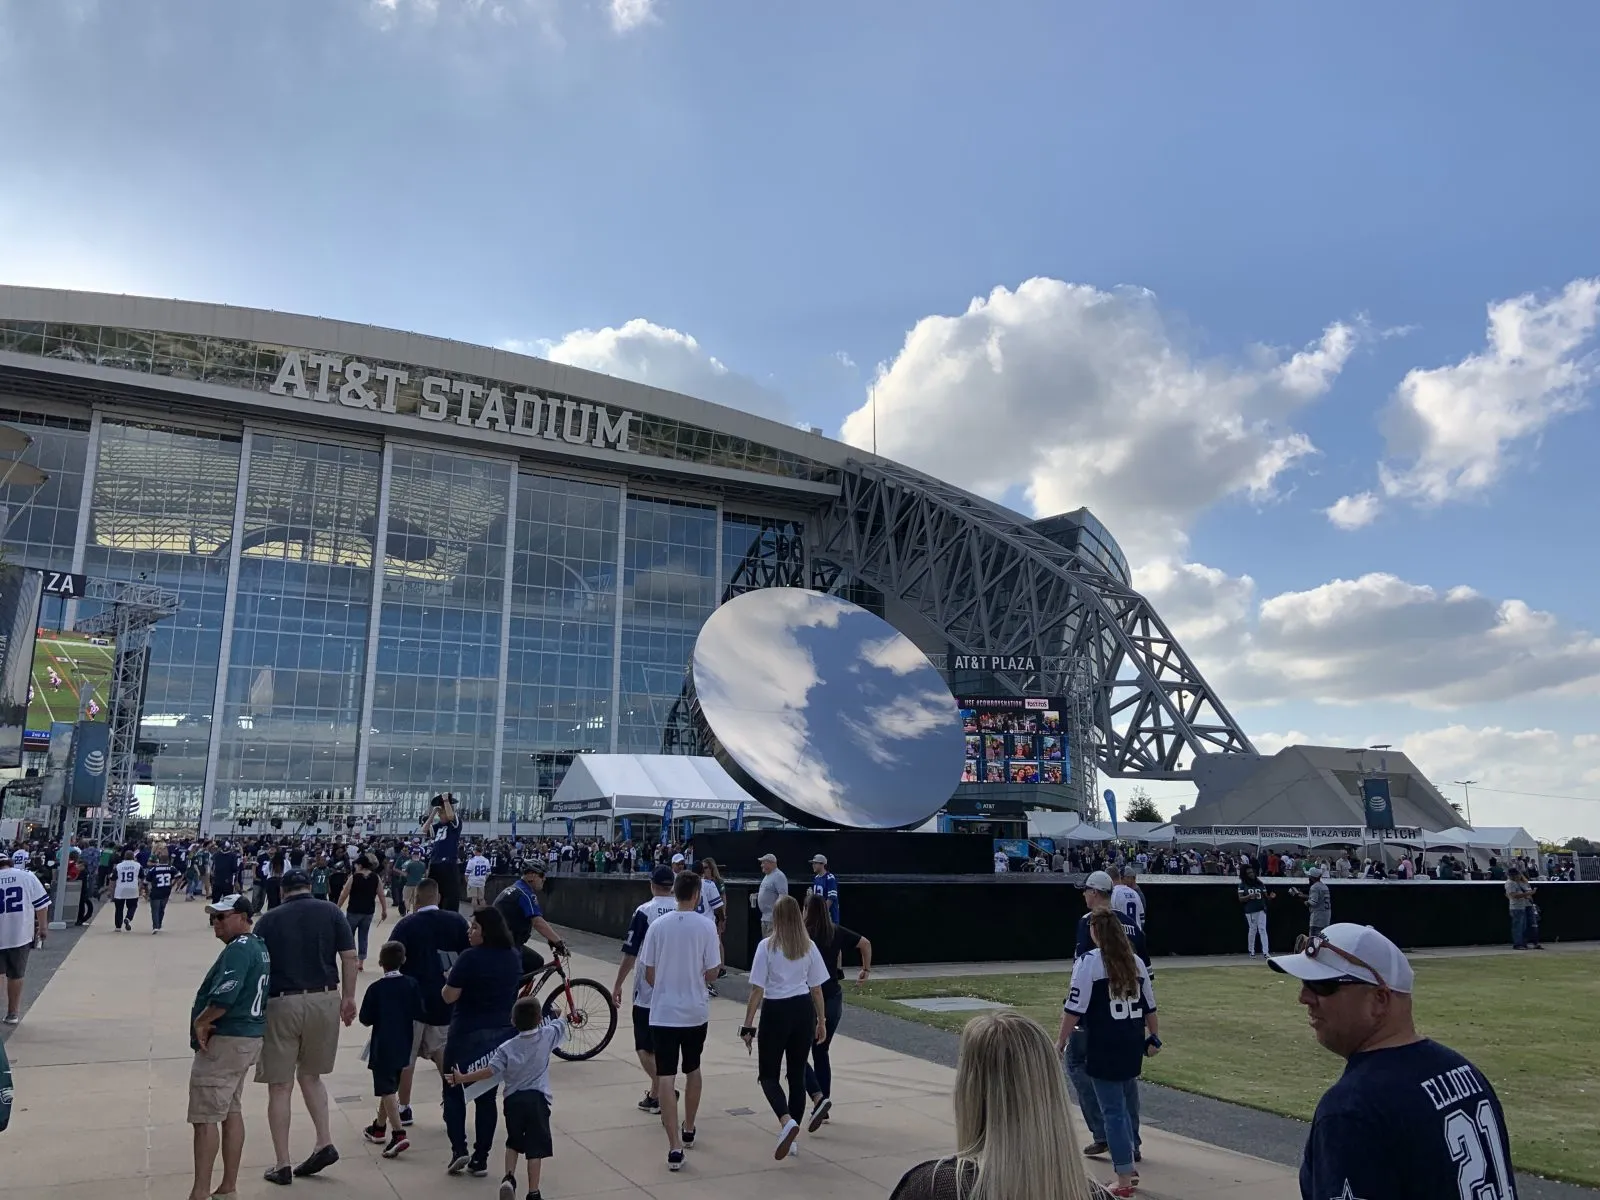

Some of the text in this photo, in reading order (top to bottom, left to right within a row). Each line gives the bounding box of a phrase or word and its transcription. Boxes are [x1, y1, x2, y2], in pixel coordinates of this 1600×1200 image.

[269, 351, 633, 451] AT&T STADIUM
[43, 572, 74, 594] ZA
[955, 655, 1035, 670] AT&T PLAZA
[672, 799, 690, 809] 5G
[691, 801, 706, 809] FAN
[706, 802, 751, 810] EXPERIECE
[1215, 827, 1240, 836] PLAZA
[1311, 829, 1339, 838] PLAZA
[1341, 829, 1361, 838] BAR
[121, 871, 134, 882] 19
[474, 865, 487, 876] 82
[156, 873, 171, 887] 33
[318, 875, 326, 884] 77
[1420, 1064, 1484, 1110] ELLIOTT
[1444, 1099, 1515, 1200] 21
